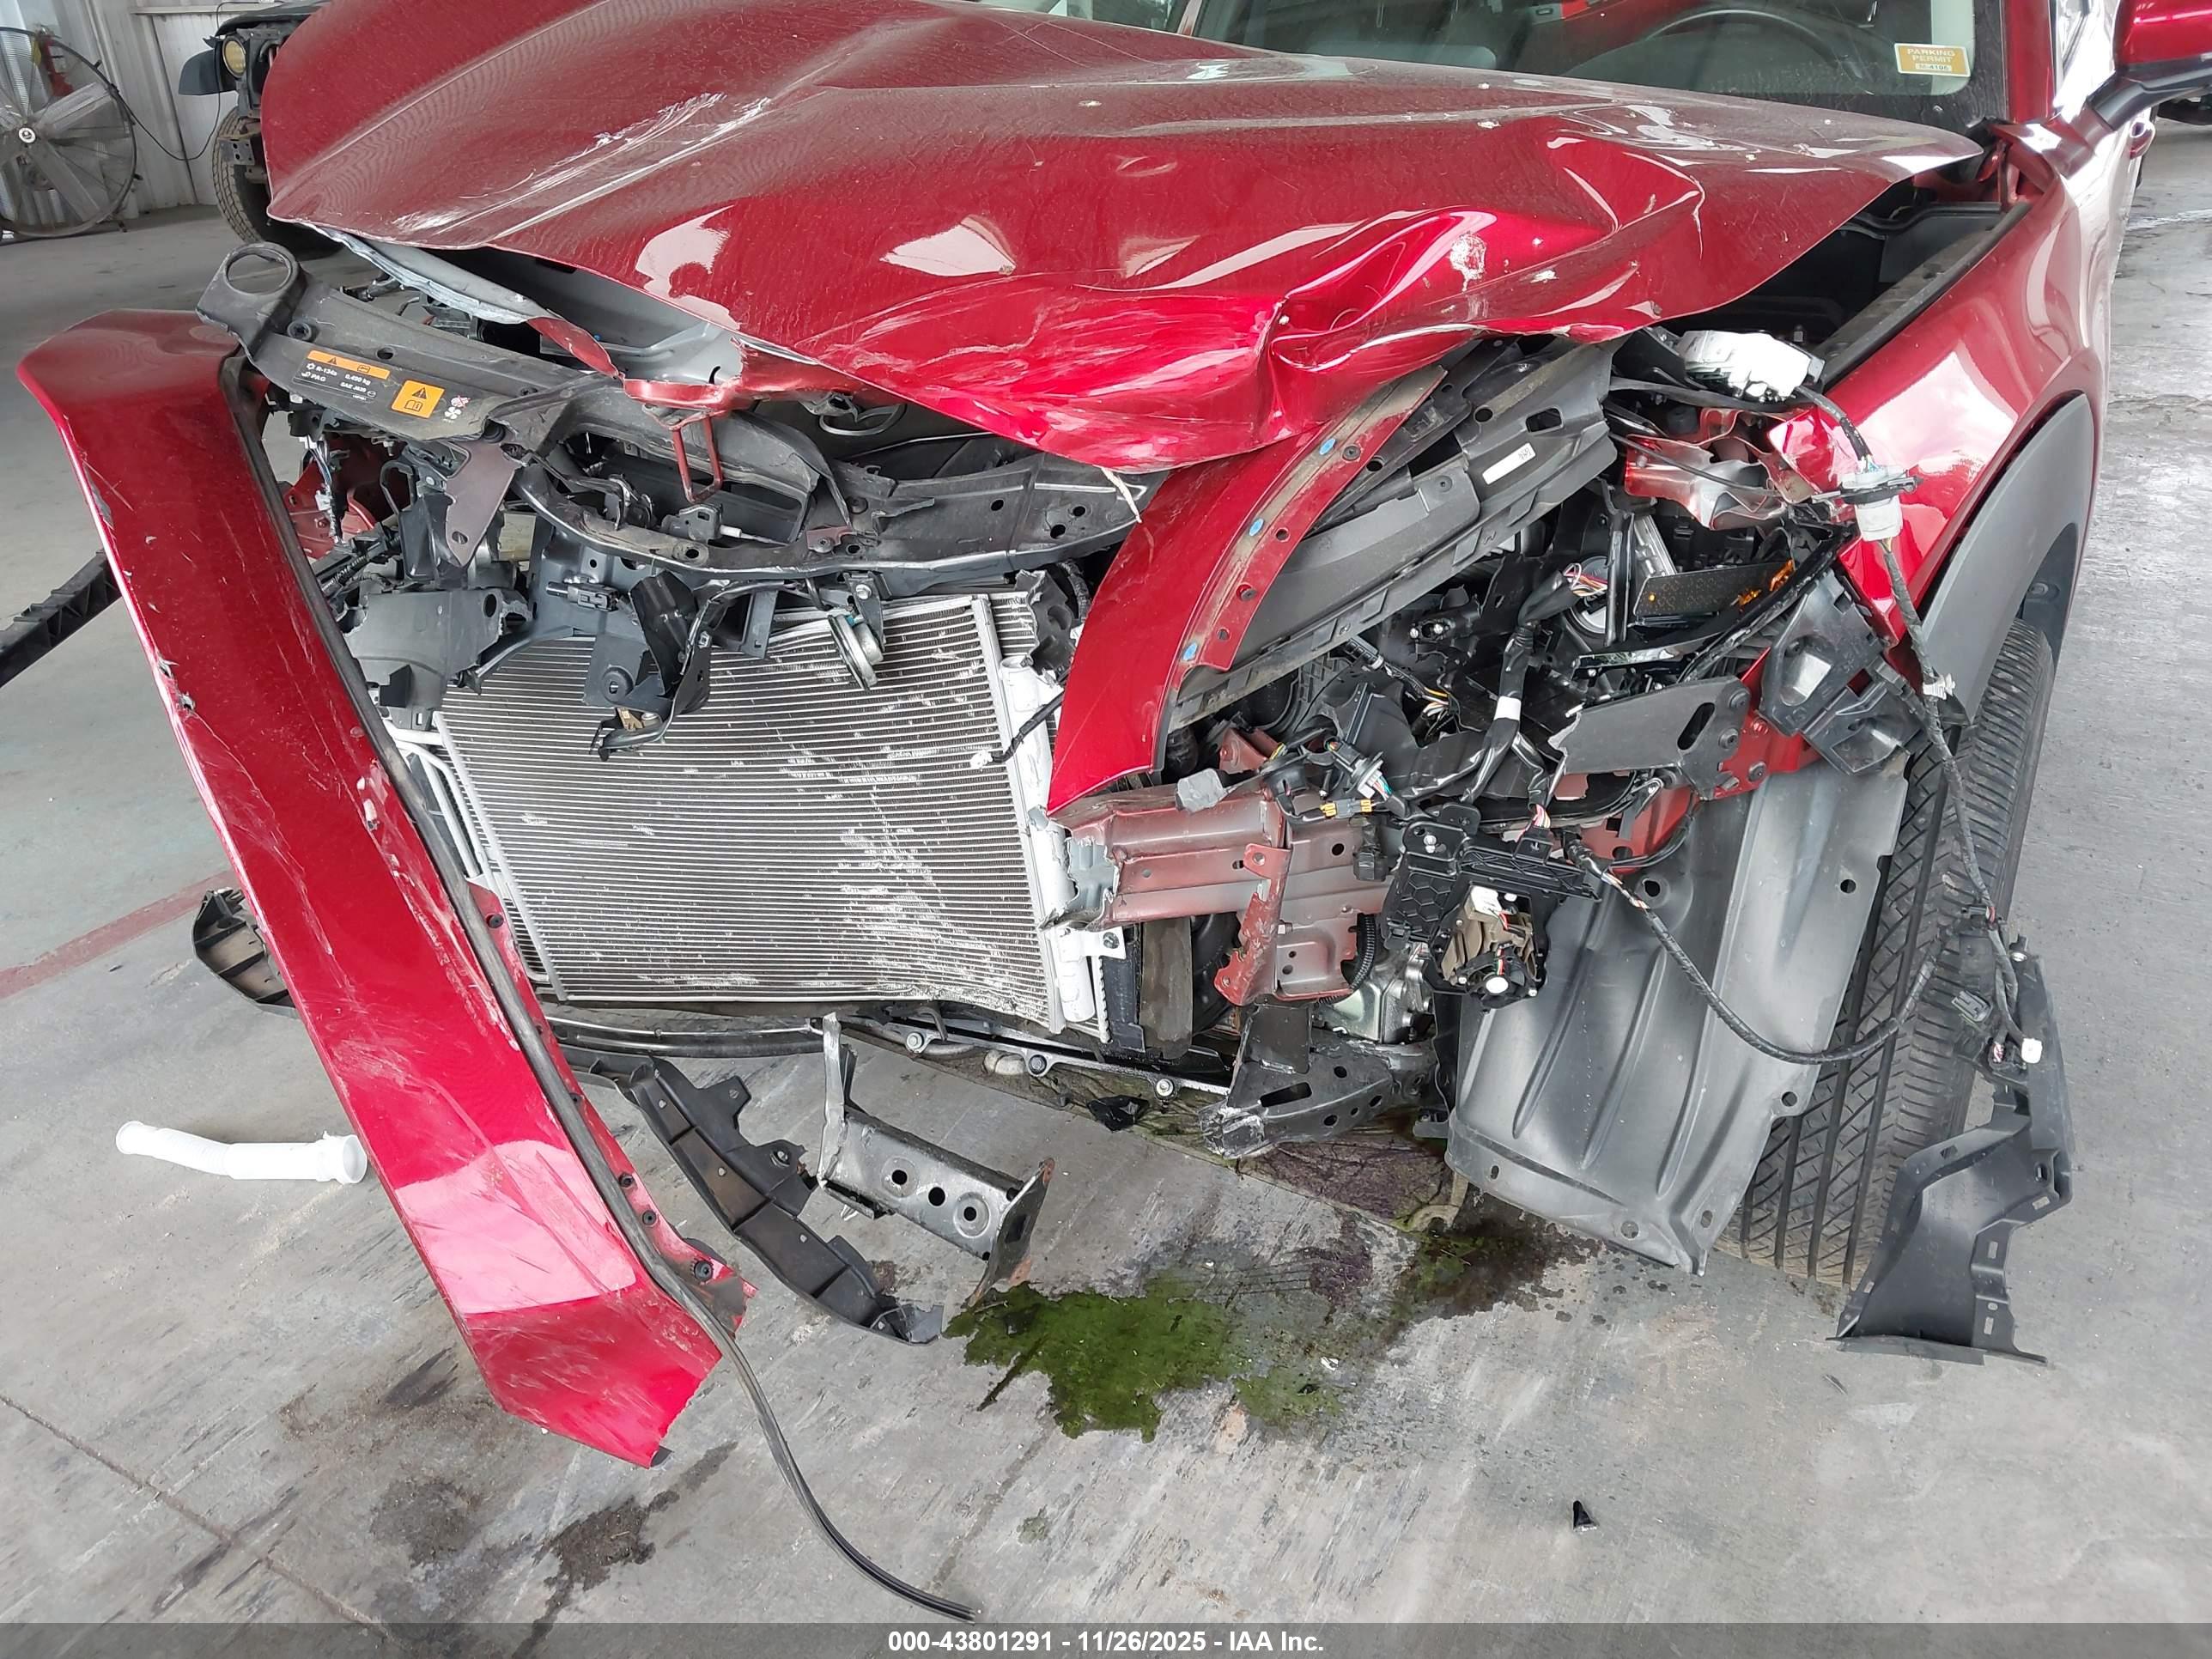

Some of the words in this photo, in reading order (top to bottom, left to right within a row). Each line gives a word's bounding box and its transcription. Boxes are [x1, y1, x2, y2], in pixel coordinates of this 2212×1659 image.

[1907, 48, 1955, 57] PARKING
[315, 366, 337, 376] R-134a
[310, 374, 326, 382] PAG
